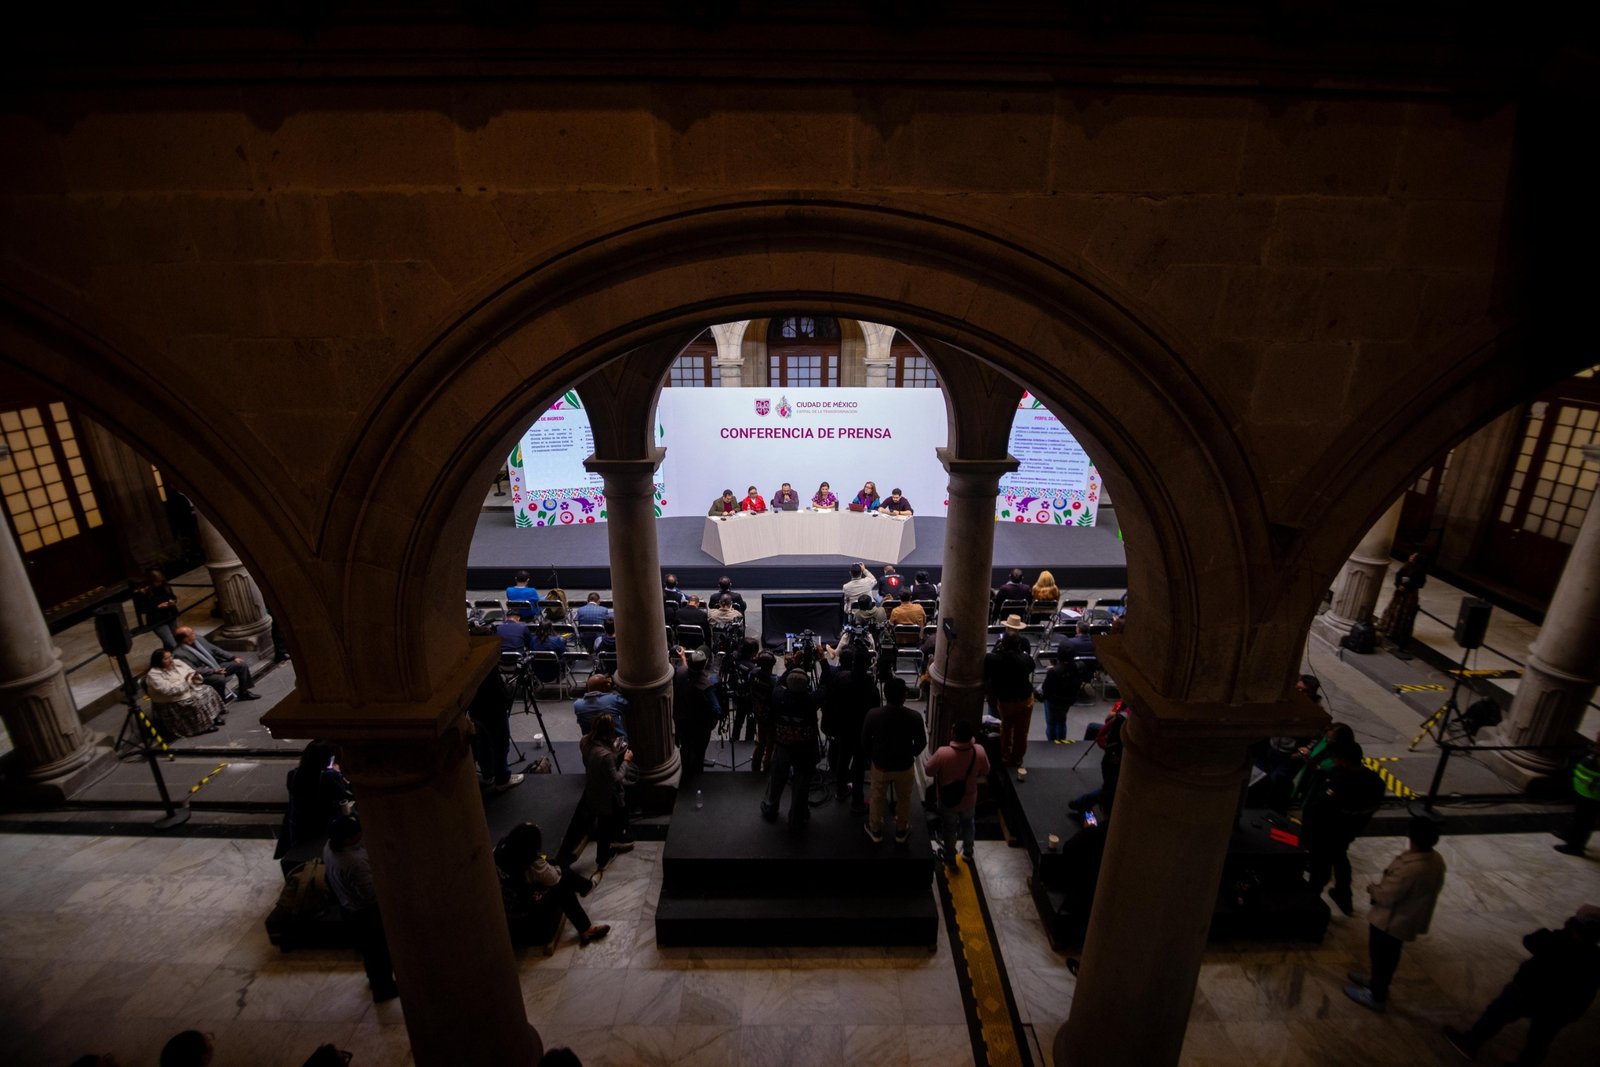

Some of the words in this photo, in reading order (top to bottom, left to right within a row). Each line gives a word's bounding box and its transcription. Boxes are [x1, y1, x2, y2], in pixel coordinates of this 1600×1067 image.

[832, 400, 858, 408] MÉXICO
[720, 427, 814, 439] CONFERENCIA
[817, 428, 835, 439] DE
[838, 428, 892, 439] PRENSA
